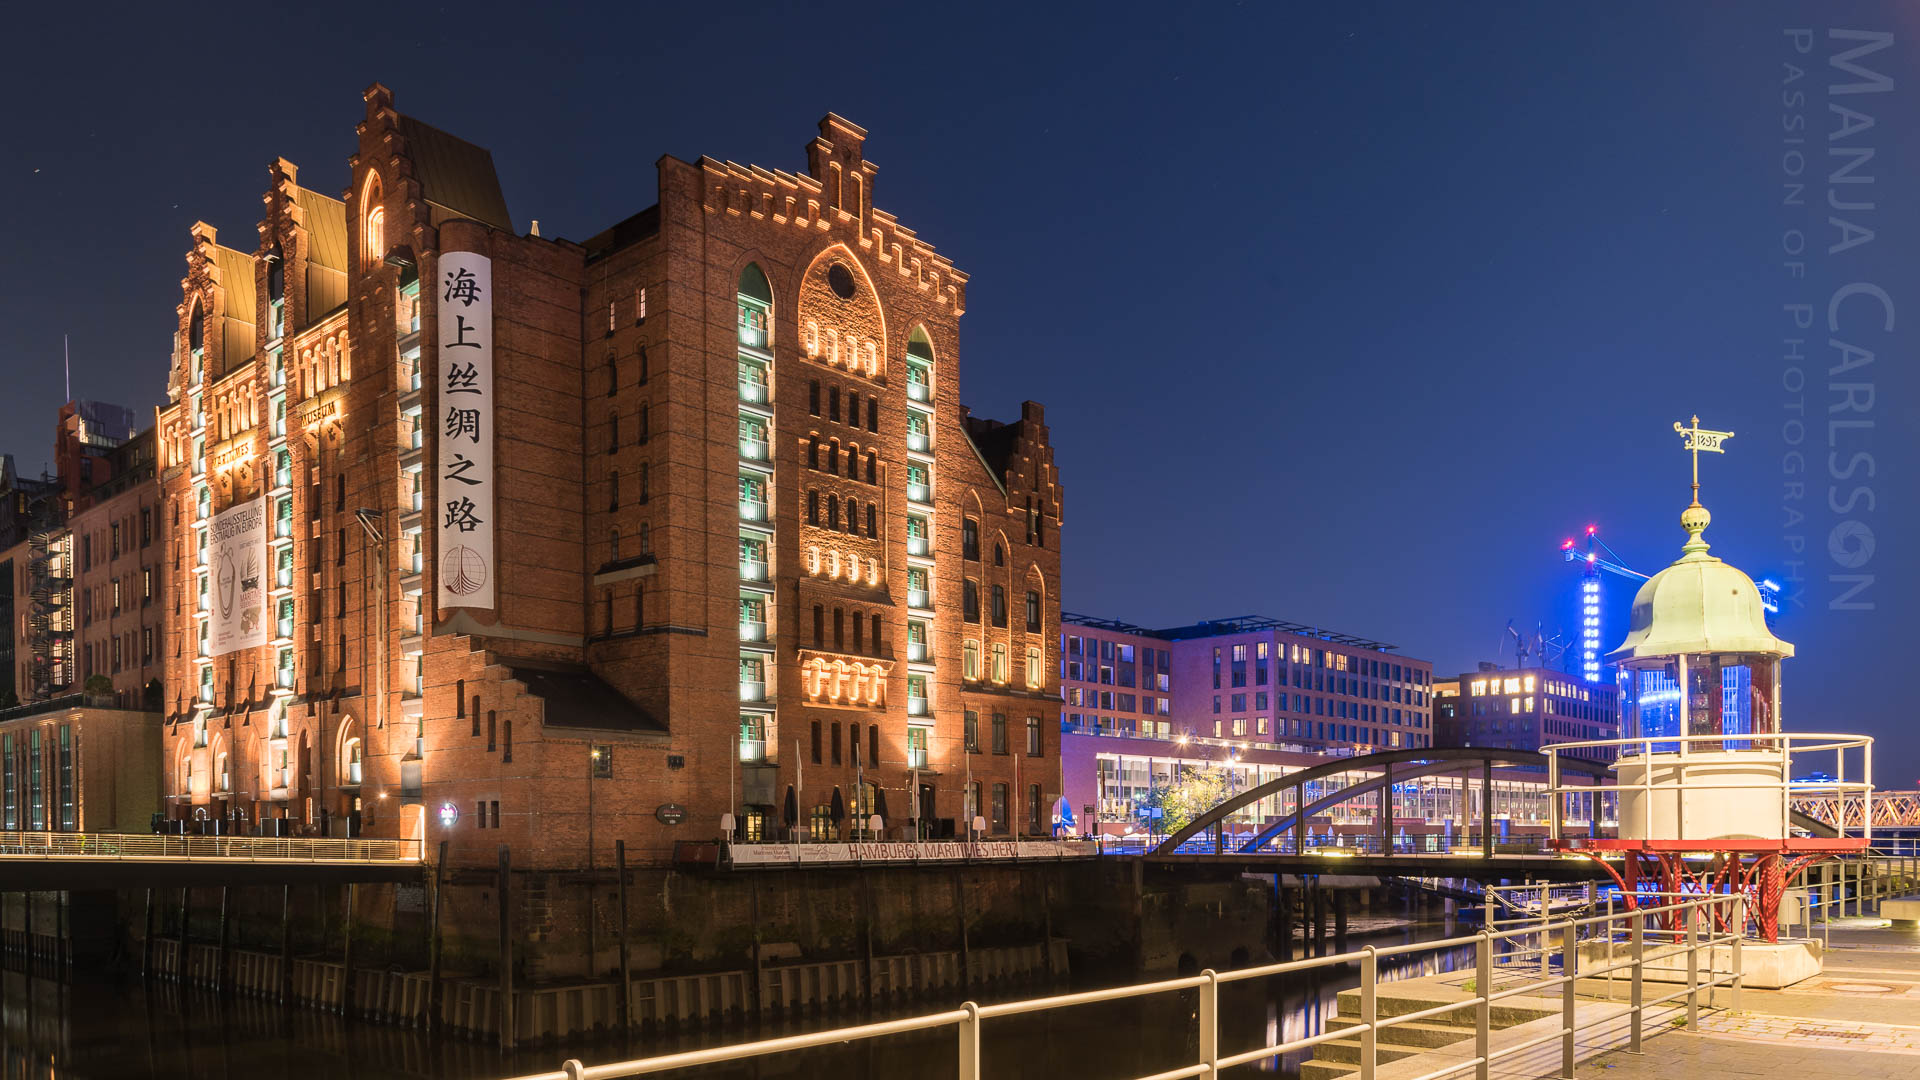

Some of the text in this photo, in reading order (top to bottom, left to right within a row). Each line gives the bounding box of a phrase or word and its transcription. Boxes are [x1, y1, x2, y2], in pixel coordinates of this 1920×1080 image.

[444, 267, 485, 533] 海上丝绸之路
[301, 401, 336, 428] MUSEUM
[1697, 434, 1718, 448] 1895
[241, 516, 263, 534] EUROPA
[848, 843, 922, 860] HAMBURGS
[924, 843, 990, 858] MARITIMES
